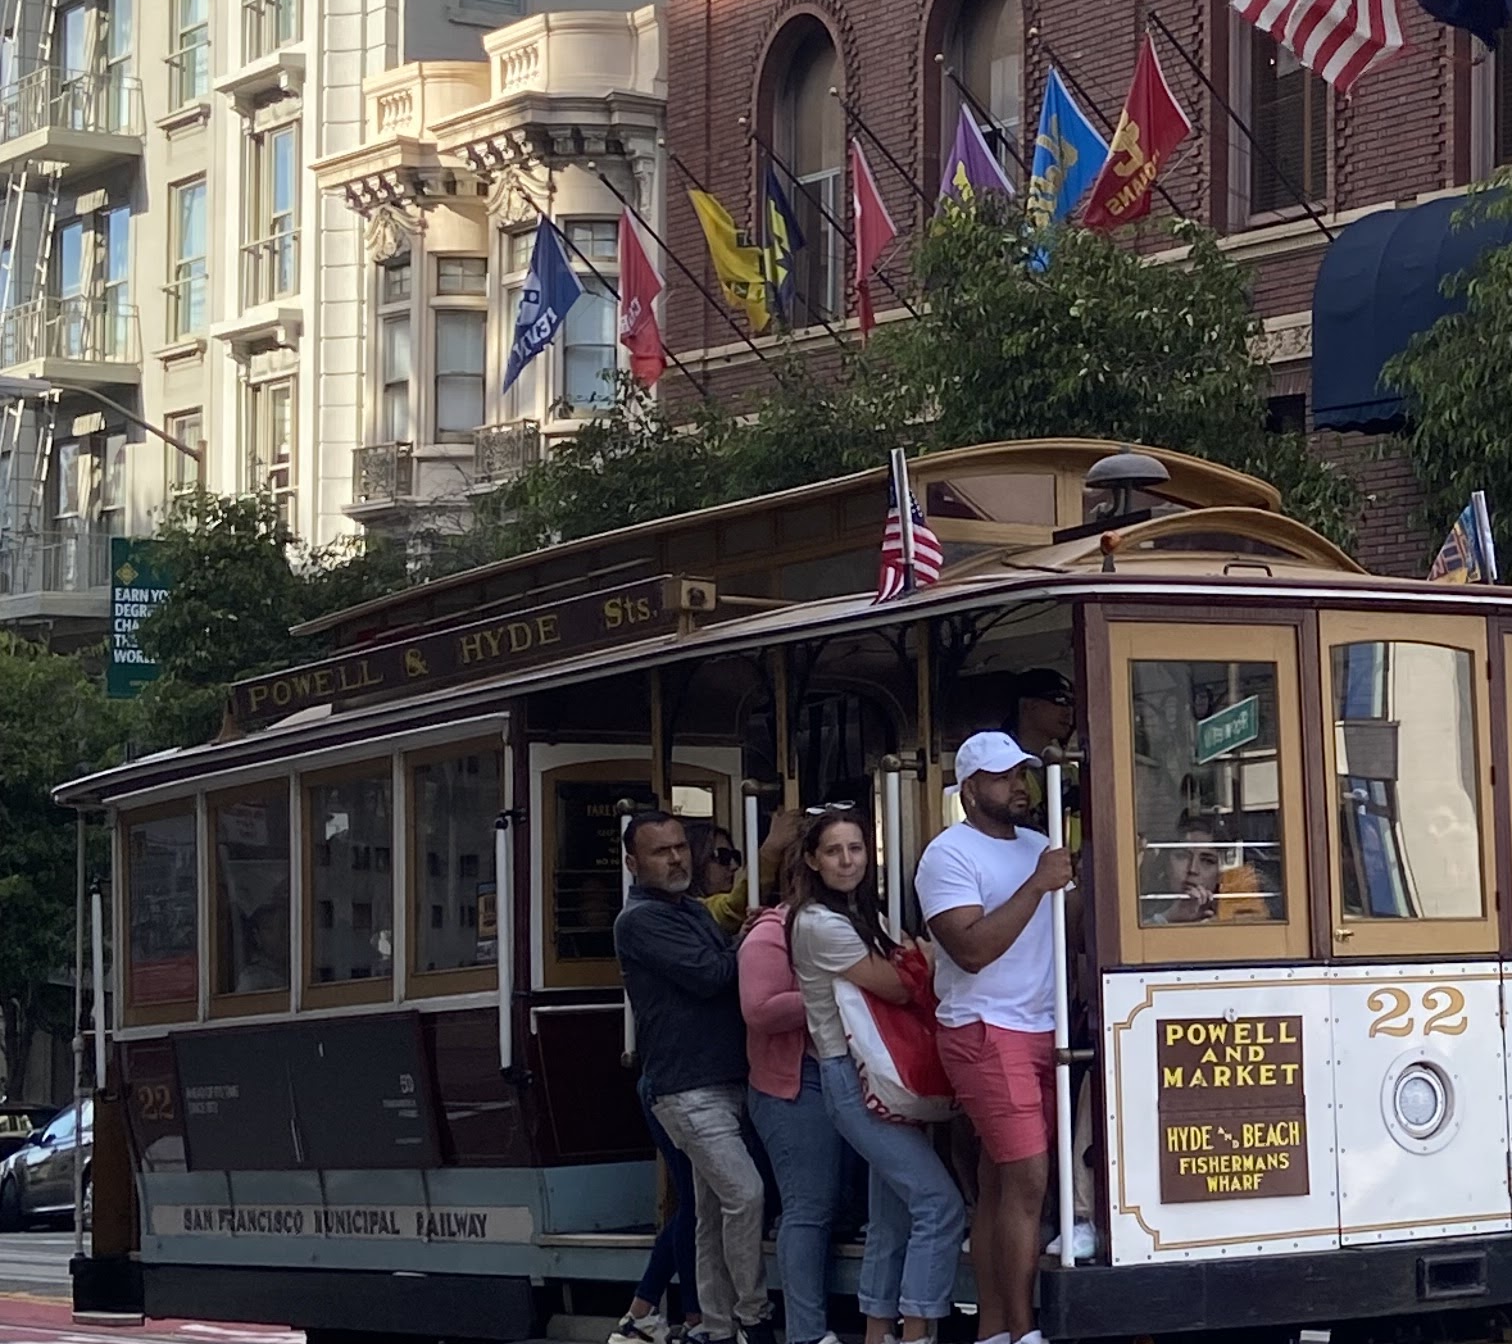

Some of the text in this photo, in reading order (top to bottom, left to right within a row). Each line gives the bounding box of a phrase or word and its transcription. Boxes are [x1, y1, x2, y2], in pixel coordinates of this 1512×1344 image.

[114, 587, 150, 603] EARN
[114, 603, 154, 618] DEGR
[247, 595, 658, 713] POWELL & HYDE Sts.
[1367, 985, 1468, 1038] 22
[1166, 1021, 1297, 1046] POWELL
[1200, 1045, 1266, 1063] AND
[1163, 1063, 1299, 1088] MARKET
[138, 1084, 174, 1120] 22
[1167, 1121, 1301, 1152] HYDE AND BEACH
[1179, 1152, 1290, 1176] FISHERMANS
[1206, 1173, 1264, 1193] WHARF
[183, 1207, 488, 1239] SAN FRANCISCO MUNICIPAL RAILWAY
